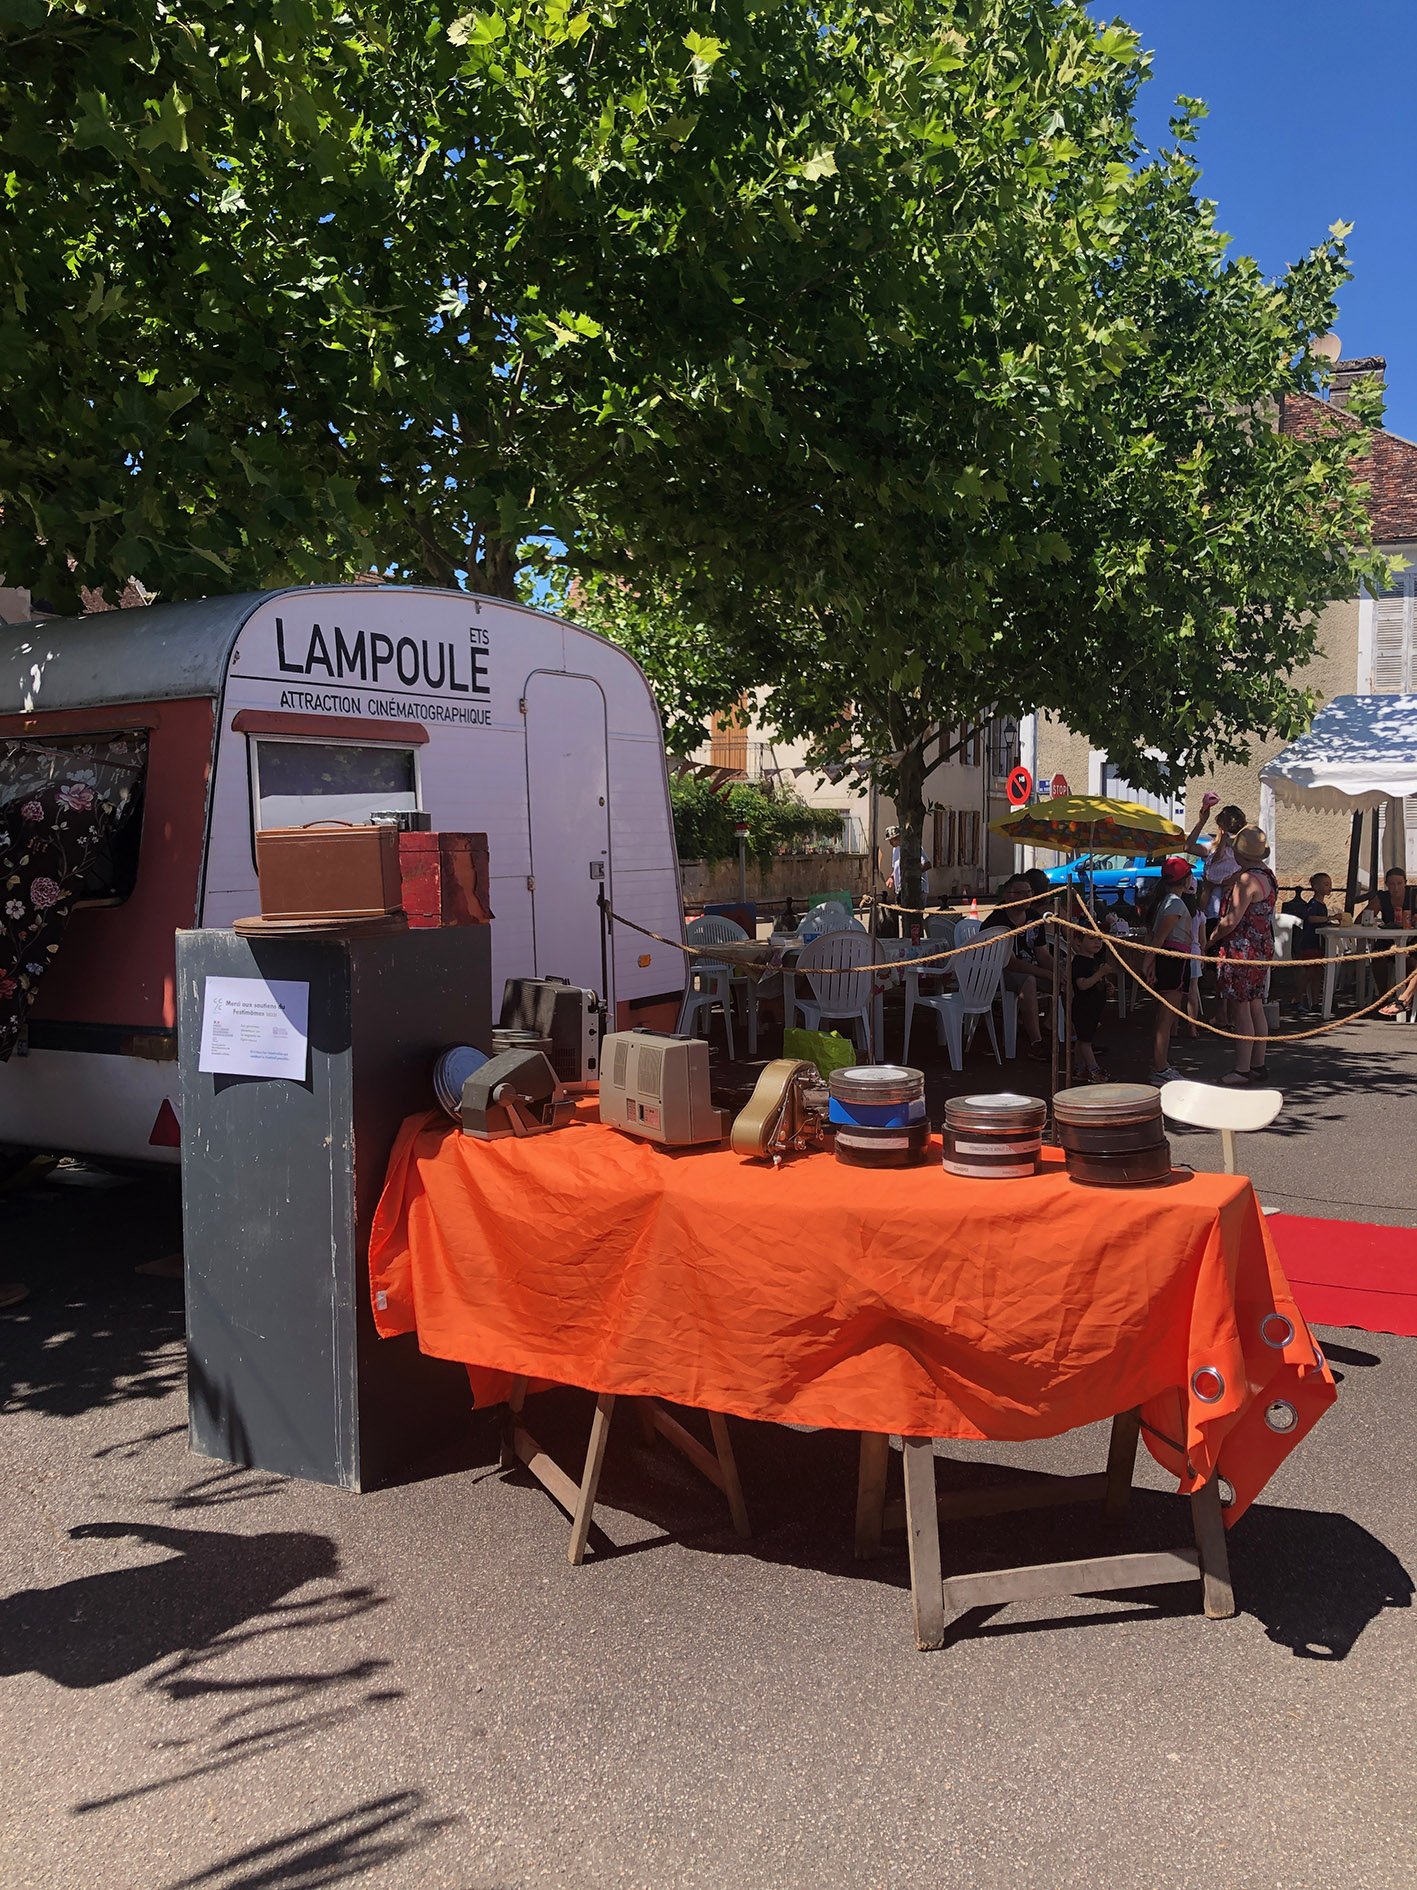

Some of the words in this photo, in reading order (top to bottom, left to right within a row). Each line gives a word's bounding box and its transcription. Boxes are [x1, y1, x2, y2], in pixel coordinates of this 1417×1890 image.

[469, 627, 490, 645] ETS
[275, 617, 491, 694] LAMPOULE
[280, 690, 361, 714] ATTRACTION
[368, 698, 492, 726] CINÉMATOGRAPHIQUE
[1052, 784, 1067, 795] STOP
